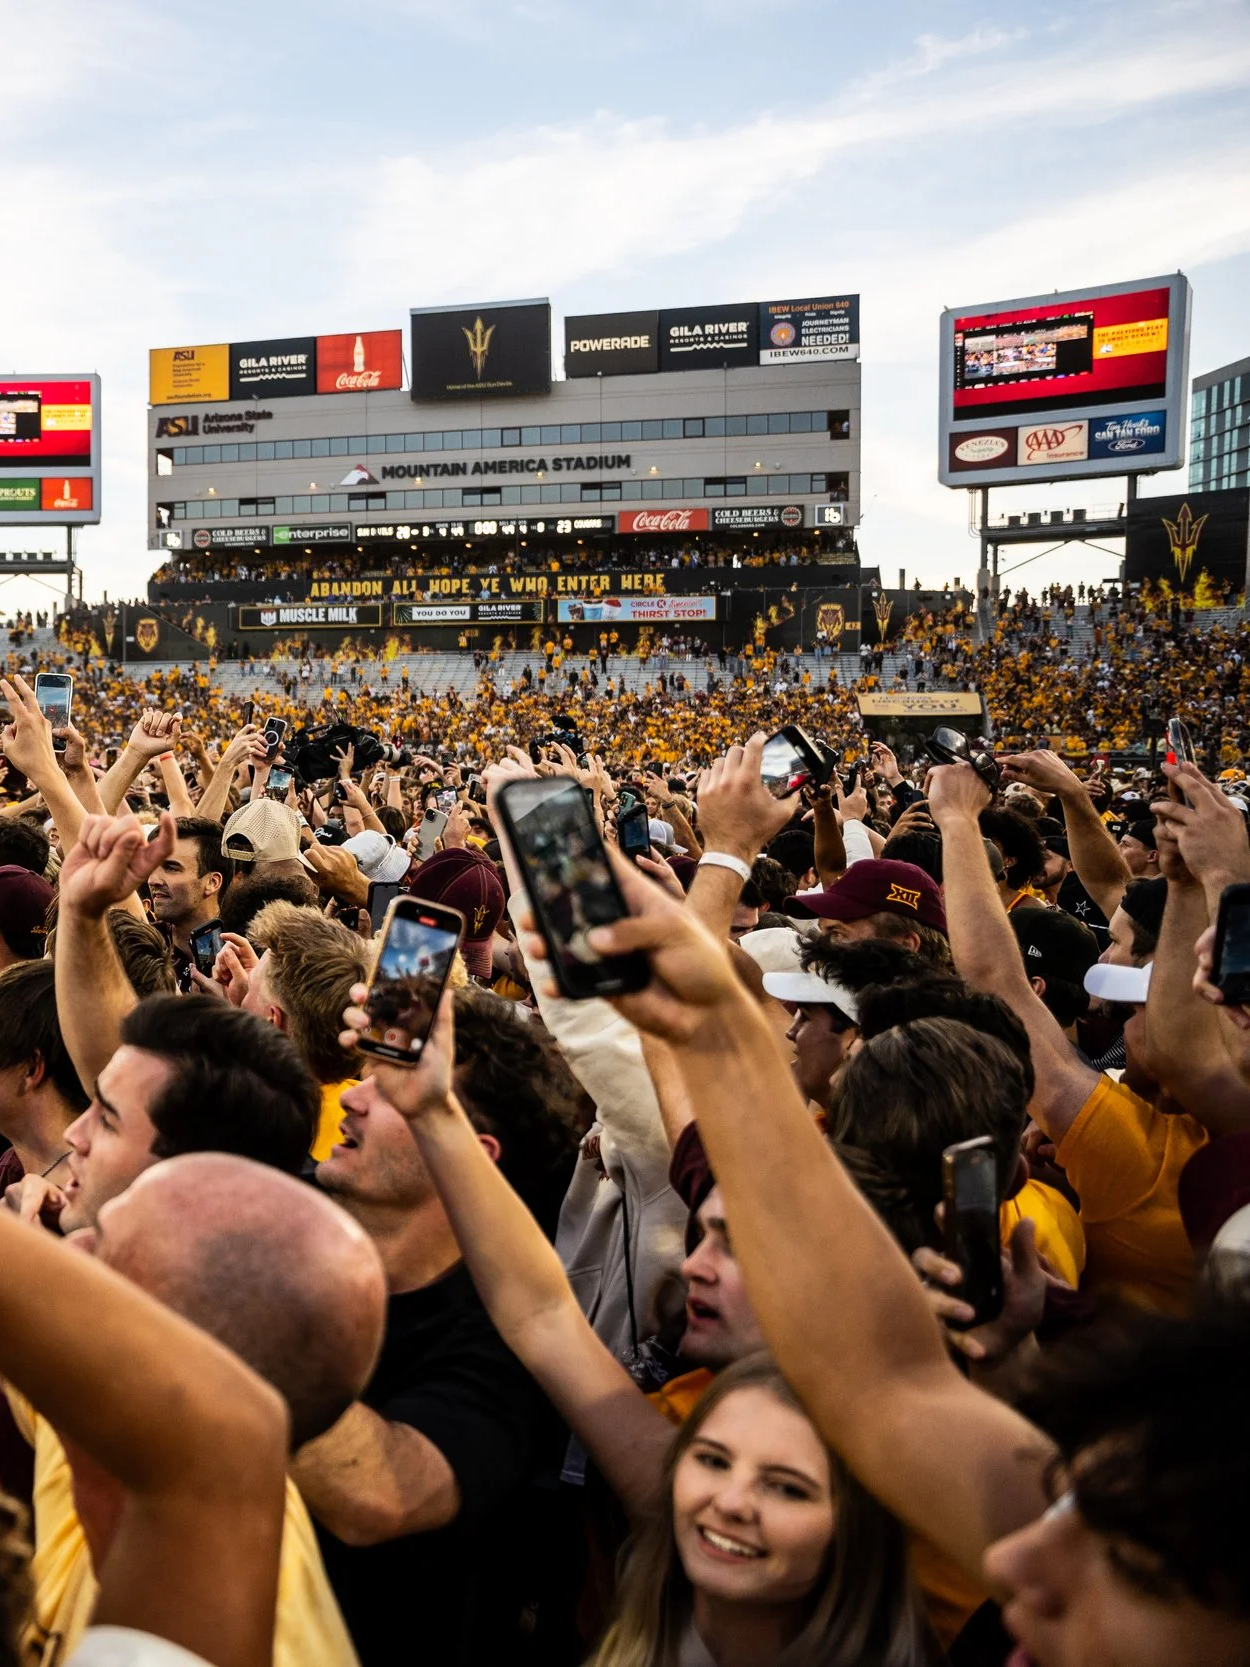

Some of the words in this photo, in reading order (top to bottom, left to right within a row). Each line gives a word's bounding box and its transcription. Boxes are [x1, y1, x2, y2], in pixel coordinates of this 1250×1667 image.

[769, 305, 790, 314] IBEW
[791, 304, 810, 312] Local
[812, 302, 834, 310] Union
[836, 301, 849, 309] 640
[801, 317, 849, 327] JOURNEYMAN
[670, 324, 702, 337] GILA
[705, 322, 747, 335] RIVER
[801, 325, 849, 334] ELECTRICIANS
[570, 335, 651, 352] POWERADE
[714, 334, 748, 342] CASINOS
[801, 333, 850, 346] NEEDED!
[173, 350, 195, 361] ASU
[770, 346, 849, 358] IBEW640.COM
[239, 356, 268, 368] GILA
[269, 354, 307, 366] RIVER
[336, 371, 381, 389] Coca-Cola
[203, 412, 243, 423] Arizona
[245, 410, 273, 420] State
[155, 415, 199, 438] ASU
[203, 422, 254, 434] University
[1095, 431, 1113, 441] SAN
[1115, 428, 1133, 438] TAN
[1135, 425, 1160, 437] FORD
[1029, 429, 1061, 450] AAA
[1114, 440, 1138, 450] Ford
[1047, 450, 1085, 459] Insurance
[381, 462, 467, 479] MOUNTAIN
[471, 458, 547, 476] AMERICA
[552, 454, 630, 472] STADIUM
[715, 509, 739, 517] COLD
[742, 508, 771, 516] BEERS
[632, 509, 693, 532] Coca-Cola
[715, 516, 779, 524] CHEESEBURGERS
[212, 529, 233, 537] COLD
[235, 528, 260, 536] BEERS
[212, 535, 266, 543] CHEESEBURGERS
[279, 526, 349, 541] enterprise
[310, 580, 383, 597] ABANDON
[391, 579, 417, 595] ALL
[429, 578, 470, 594] HOPE
[480, 578, 500, 592] YE
[510, 577, 548, 592] WHO
[557, 574, 610, 591] ENTER
[621, 573, 665, 590] HERE
[279, 608, 325, 623] MUSCLE
[328, 607, 358, 623] MILK
[631, 609, 671, 619] THIRST
[673, 608, 706, 618] STOP!
[888, 884, 920, 909] XII
